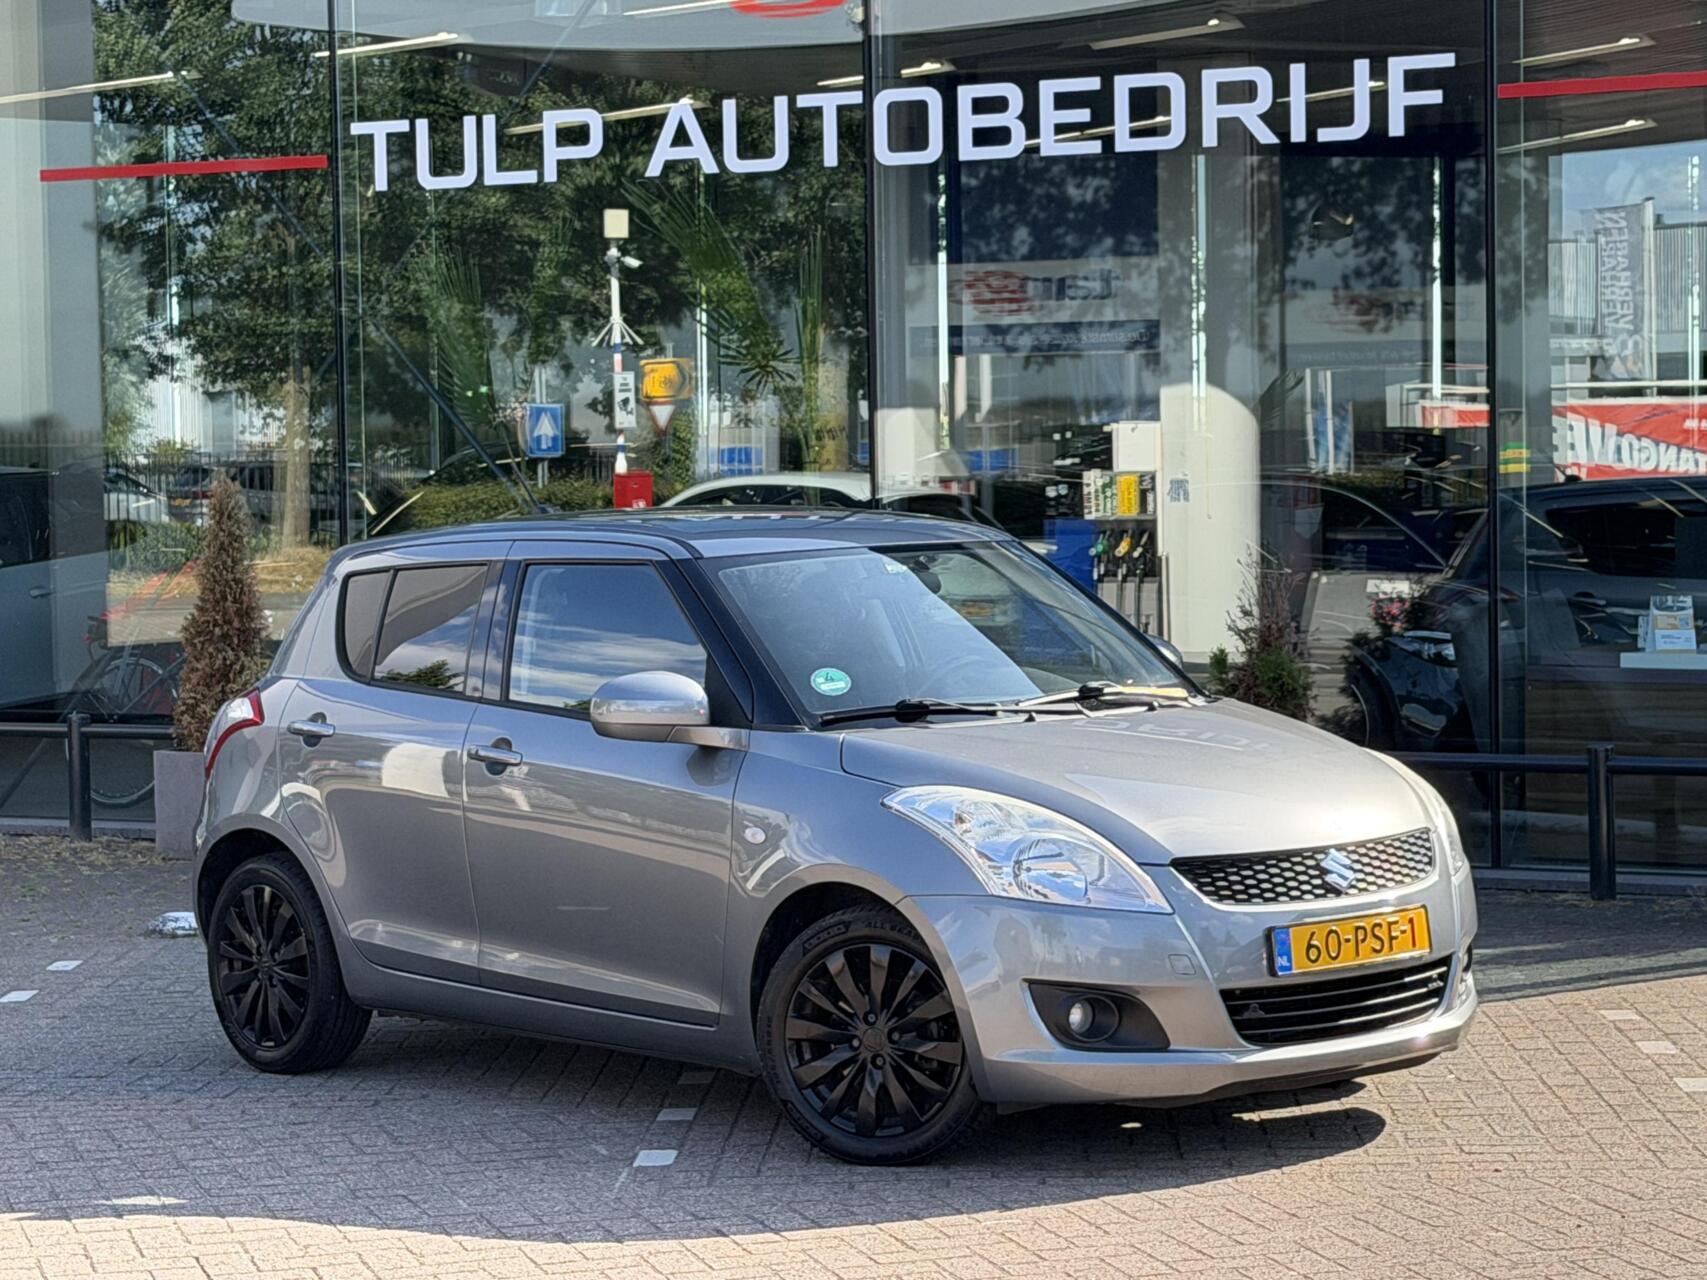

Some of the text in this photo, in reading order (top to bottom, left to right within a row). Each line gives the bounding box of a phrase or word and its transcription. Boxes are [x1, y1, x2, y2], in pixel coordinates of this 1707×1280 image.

[350, 52, 1457, 192] TULP AUTOBEDRIJF
[1277, 955, 1290, 968] NL
[1305, 916, 1417, 964] 60-PSF-1
